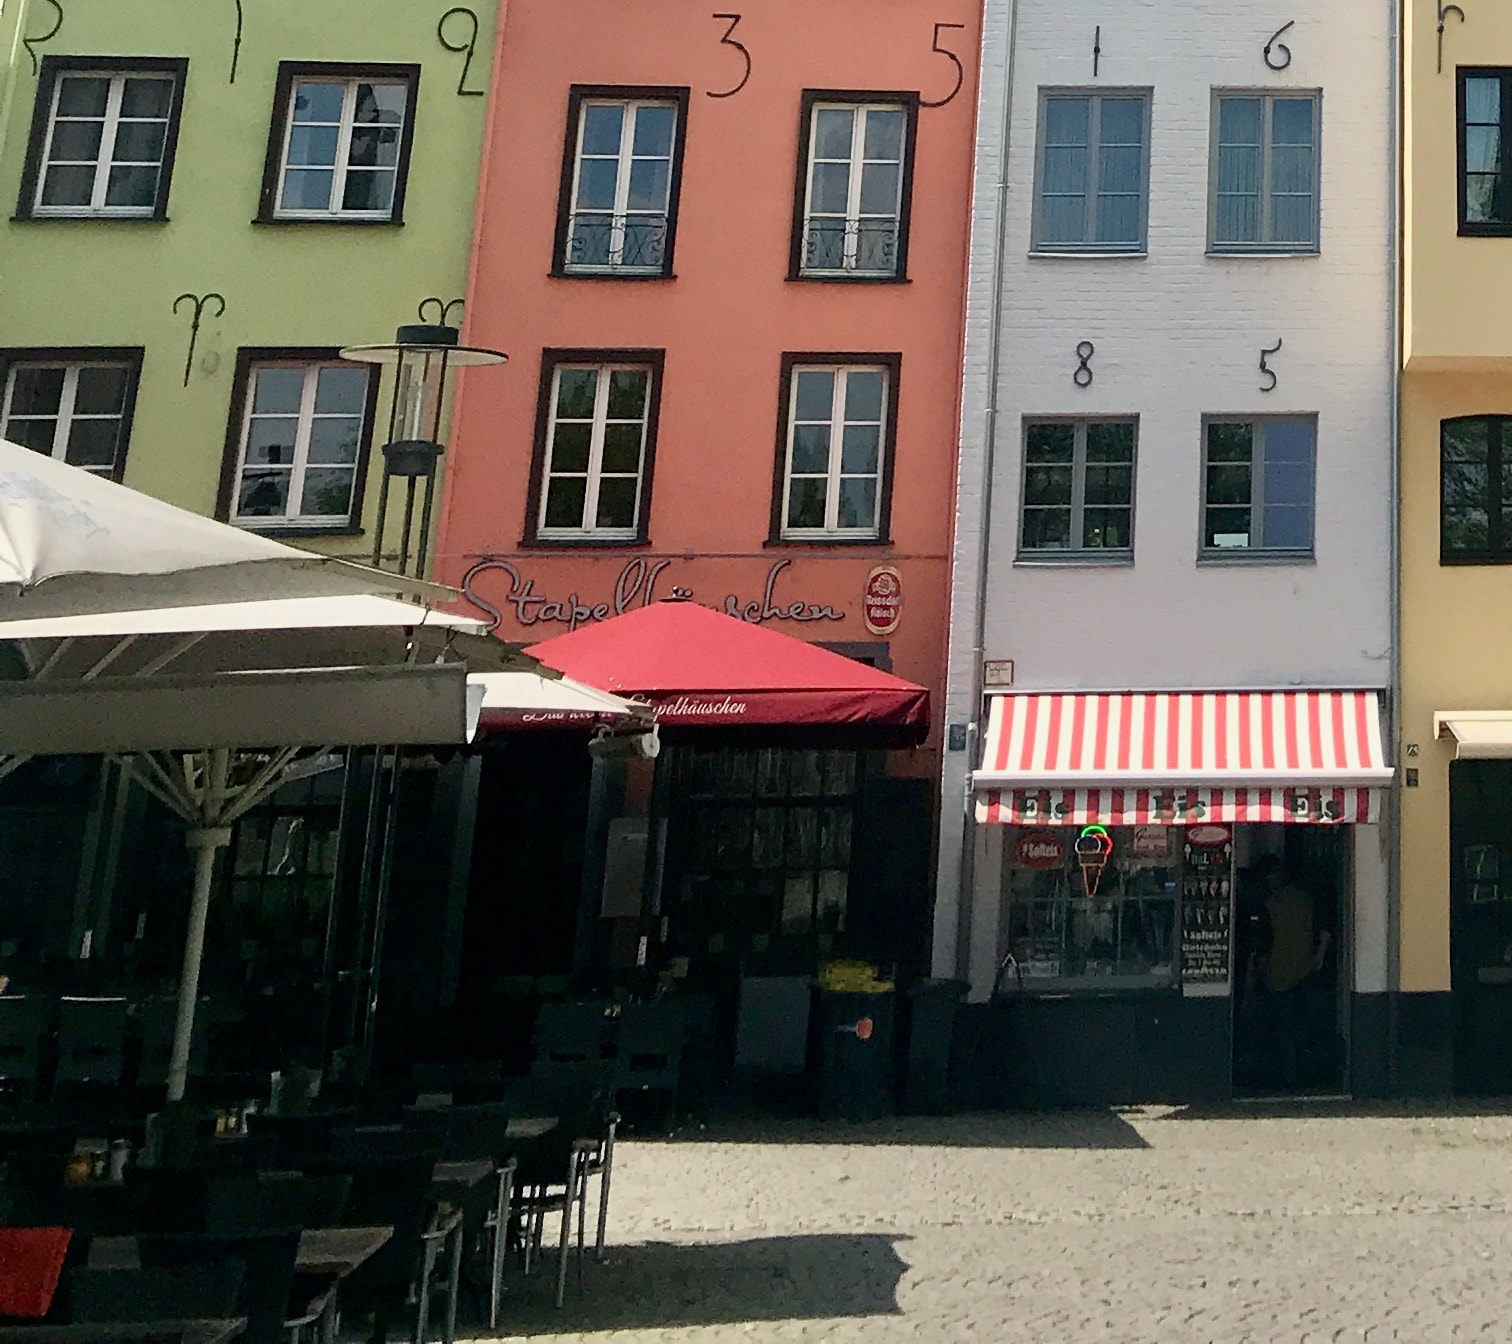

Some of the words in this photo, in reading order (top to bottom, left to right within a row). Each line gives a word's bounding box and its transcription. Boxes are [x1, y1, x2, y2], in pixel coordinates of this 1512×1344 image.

[1263, 20, 1295, 71] 6
[1073, 340, 1095, 388] 8
[1258, 337, 1283, 392] 5
[1018, 795, 1070, 820] Eis
[1152, 795, 1207, 820] Eis
[1291, 794, 1341, 820] Eis
